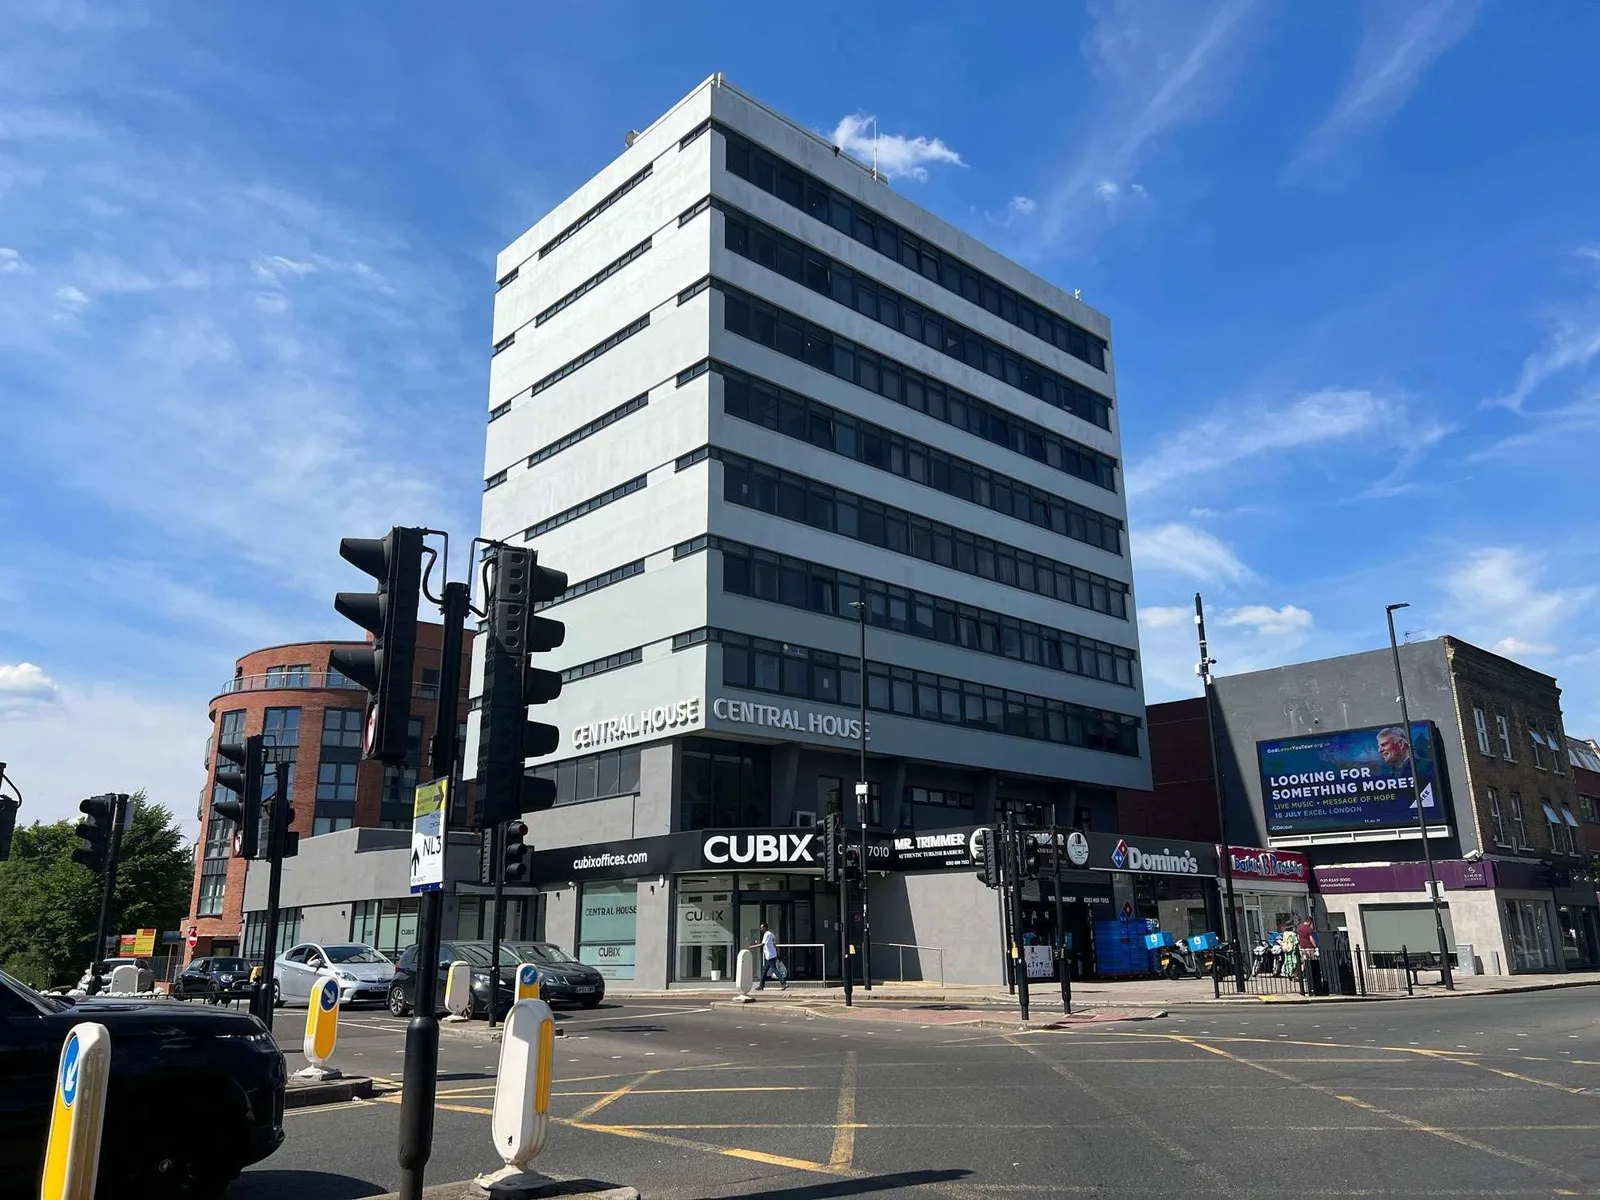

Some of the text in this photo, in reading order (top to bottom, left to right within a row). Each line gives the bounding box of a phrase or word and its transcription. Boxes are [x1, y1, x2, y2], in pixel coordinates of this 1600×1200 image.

[571, 697, 700, 748] CENTRAL HOUSE
[713, 698, 871, 740] CENTRAL HOUSE
[1270, 767, 1371, 787] LOOKING FOR
[1272, 776, 1415, 800] SOMETHING MORE?
[1273, 793, 1396, 810] LIVE MUSIC MESSAGE OF HOPE
[1284, 810, 1302, 818] JULY
[1303, 808, 1327, 816] EXCEL
[1328, 806, 1362, 815] LONDON
[423, 836, 442, 857] NL3
[704, 834, 814, 863] CUBIX
[894, 833, 965, 850] MR. TRIMMER
[573, 851, 647, 870] cubixoffices.com
[868, 845, 890, 858] 7010
[898, 851, 922, 859] AUTHENTIC
[1127, 847, 1198, 873] Domino's
[1231, 854, 1261, 876] baskin
[585, 905, 637, 917] CENTRAL HOUSE
[598, 947, 621, 957] CUBIX
